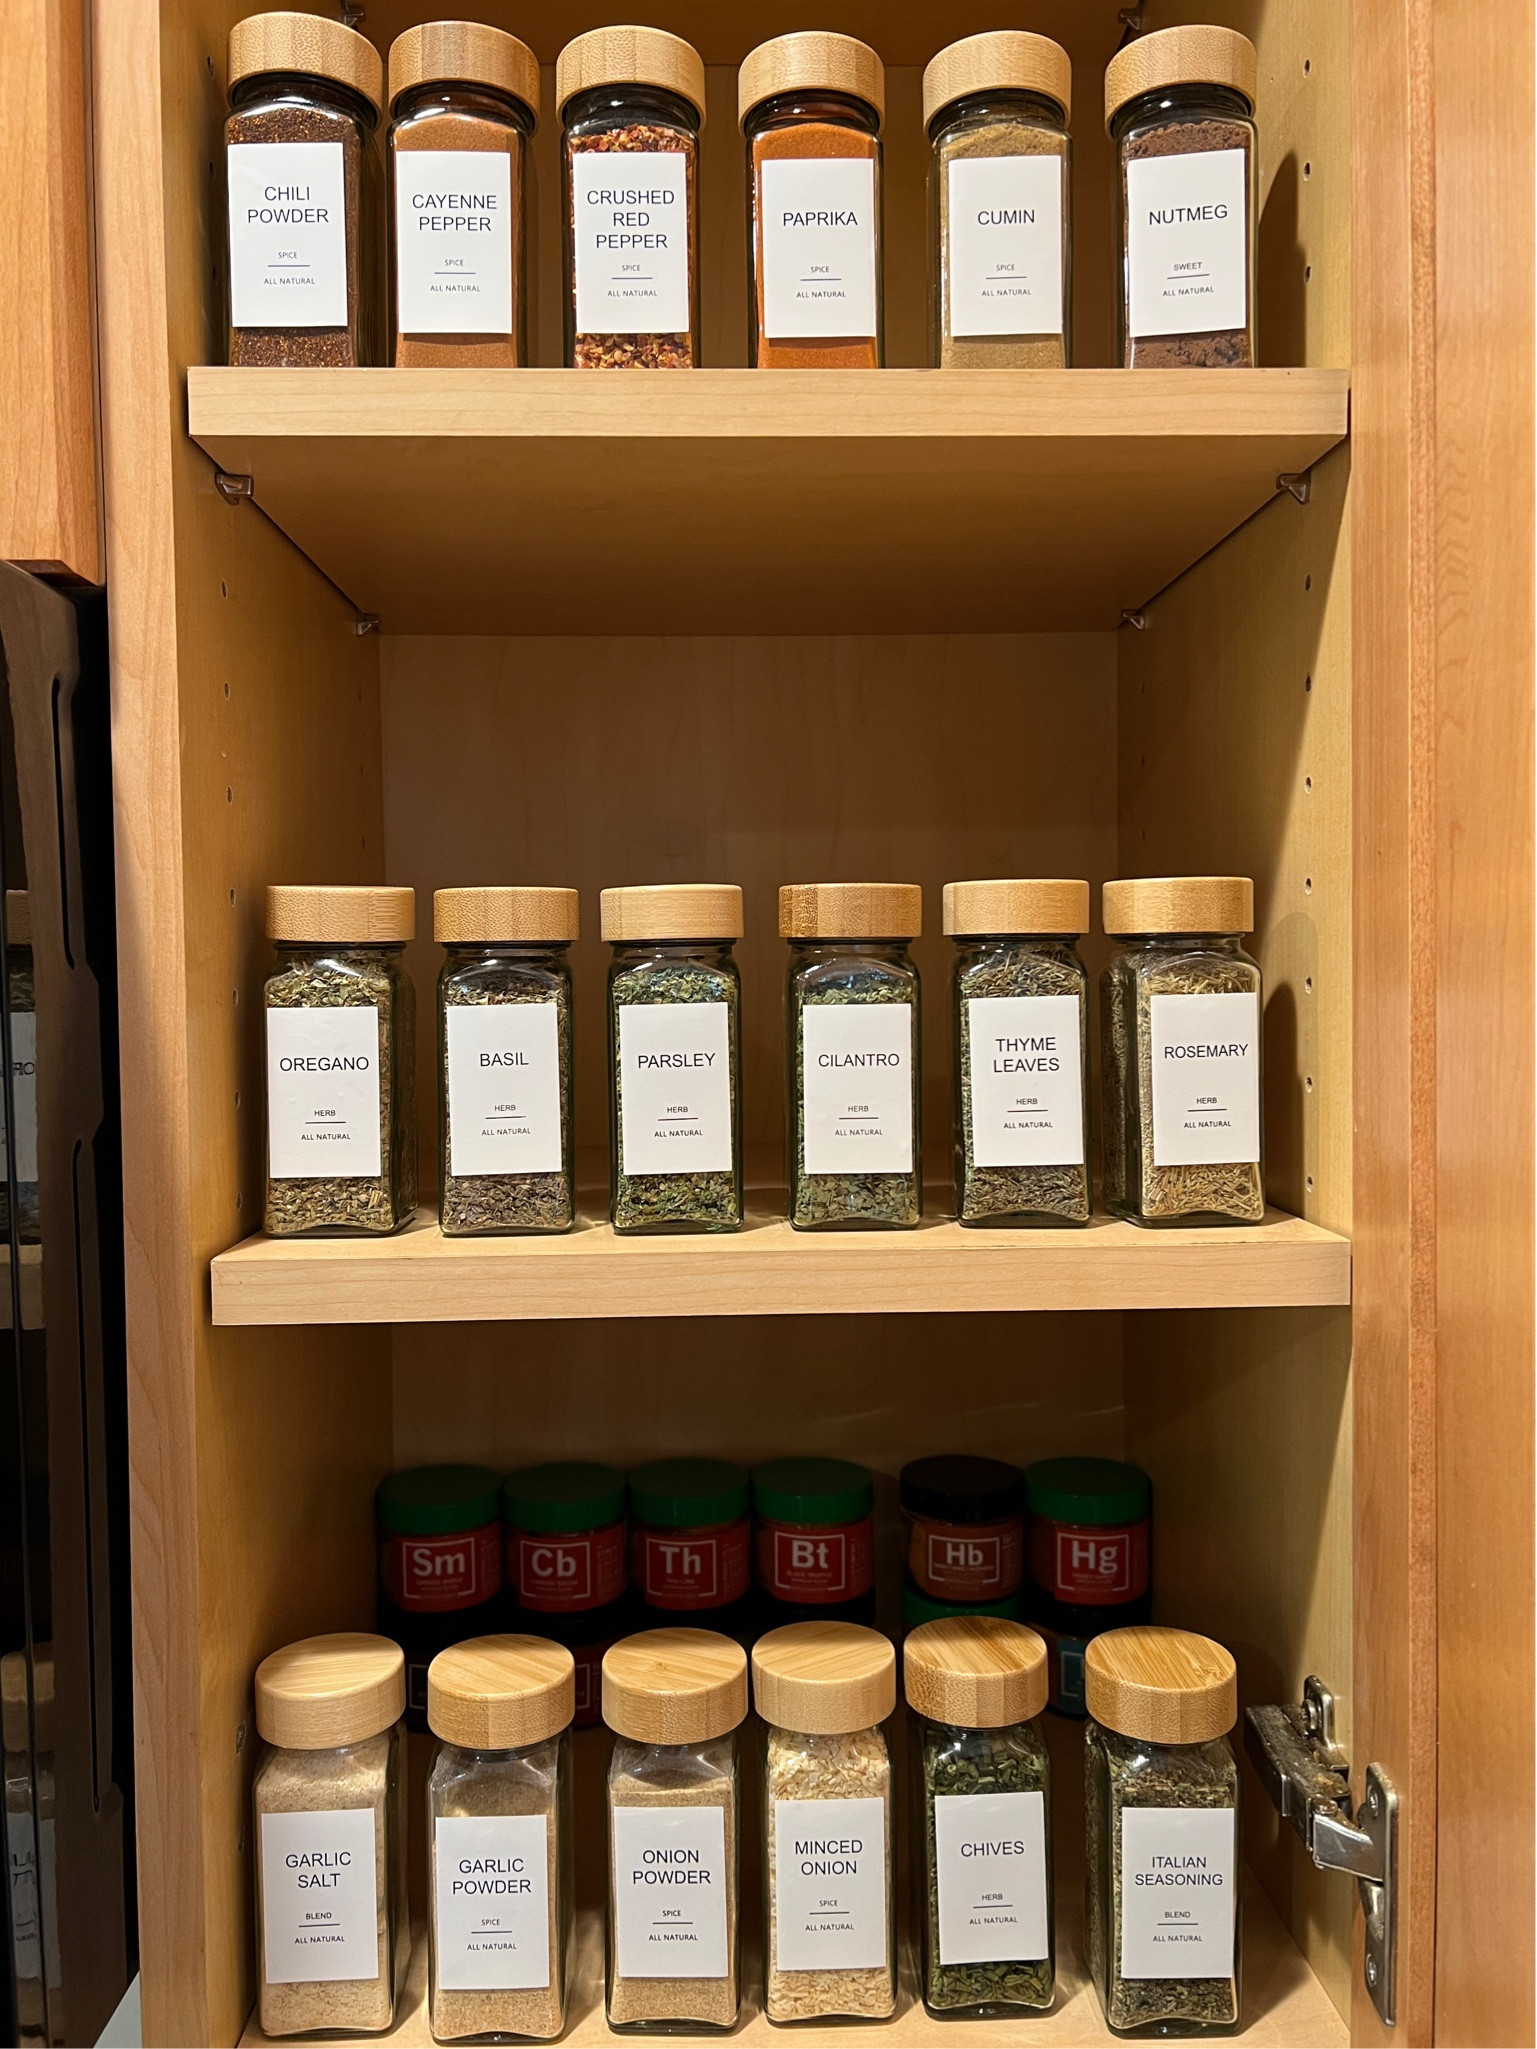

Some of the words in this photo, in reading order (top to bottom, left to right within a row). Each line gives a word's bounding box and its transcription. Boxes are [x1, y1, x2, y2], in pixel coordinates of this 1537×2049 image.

[265, 187, 309, 201] CHILI
[587, 190, 674, 204] CRUSHED
[413, 195, 497, 209] CAYENNE
[248, 209, 328, 223] POWDER
[614, 213, 649, 226] RED
[784, 212, 858, 226] PAPRIKA
[978, 210, 1034, 225] CUMIN
[1150, 205, 1227, 225] NUTMEG
[420, 217, 491, 231] PEPPER
[597, 234, 667, 248] PEPPER
[277, 251, 298, 259] SPICE
[444, 258, 464, 267] SPICE
[621, 264, 641, 272] SPICE
[995, 263, 1016, 272] SPICE
[1173, 261, 1203, 272] SWEET
[810, 265, 830, 274] SPICE
[263, 277, 278, 285] ALL
[279, 277, 316, 285] NATURAL
[429, 284, 444, 292] ALL
[445, 284, 481, 293] NATURAL
[607, 289, 621, 298] ALL
[622, 289, 658, 297] NATURAL
[981, 289, 995, 297] ALL
[996, 288, 1032, 297] NATURAL
[1162, 289, 1177, 297] ALL
[1177, 285, 1215, 296] NATURAL
[796, 291, 810, 299] ALL
[811, 290, 847, 298] NATURAL
[995, 1037, 1056, 1052] THYME
[1165, 1044, 1248, 1059] ROSEMARY
[280, 1057, 369, 1071] OREGANO
[480, 1052, 529, 1066] BASIL
[638, 1053, 715, 1068] PARSLEY
[819, 1054, 899, 1067] CILANTRO
[994, 1058, 1059, 1072] LEAVES
[1015, 1097, 1039, 1106] HERB
[1196, 1096, 1218, 1105] HERB
[314, 1109, 337, 1117] HERB
[494, 1104, 517, 1112] HERB
[666, 1105, 689, 1114] HERB
[847, 1105, 870, 1113] HERB
[1003, 1122, 1017, 1130] ALL
[1018, 1121, 1054, 1129] NATURAL
[1183, 1121, 1197, 1129] ALL
[1198, 1120, 1232, 1128] NATURAL
[316, 1133, 351, 1141] NATURAL
[496, 1127, 531, 1136] NATURAL
[654, 1130, 668, 1138] ALL
[668, 1129, 703, 1137] NATURAL
[834, 1129, 848, 1137] ALL
[849, 1128, 884, 1136] NATURAL
[659, 1545, 702, 1575] Th
[791, 1540, 830, 1569] Bt
[945, 1542, 984, 1567] Hb
[1071, 1540, 1119, 1574] Hg
[413, 1548, 466, 1577] Sm
[531, 1548, 577, 1577] Cb
[796, 1840, 862, 1854] MINCED
[961, 1841, 1024, 1857] CHIVES
[286, 1852, 351, 1868] GARLIC
[643, 1850, 699, 1863] ONION
[459, 1859, 523, 1873] GARLIC
[801, 1861, 856, 1875] ONION
[1153, 1857, 1206, 1868] ITALIAN
[298, 1873, 340, 1888] SALT
[633, 1871, 711, 1884] POWDER
[1135, 1874, 1222, 1885] SEASONING
[453, 1880, 531, 1895] POWDER
[981, 1893, 1004, 1901] HERB
[819, 1899, 838, 1908] SPICE
[305, 1911, 333, 1921] BLEND
[662, 1909, 682, 1917] SPICE
[1164, 1910, 1191, 1919] BLEND
[481, 1918, 501, 1927] SPICE
[969, 1917, 982, 1925] ALL
[983, 1916, 1018, 1924] NATURAL
[804, 1924, 819, 1932] ALL
[819, 1923, 855, 1931] NATURAL
[294, 1937, 309, 1945] ALL
[309, 1935, 345, 1944] NATURAL
[648, 1933, 662, 1942] ALL
[663, 1933, 699, 1941] NATURAL
[1152, 1935, 1166, 1943] ALL
[1167, 1934, 1203, 1942] NATURAL
[466, 1943, 481, 1951] ALL
[482, 1942, 517, 1951] NATURAL
